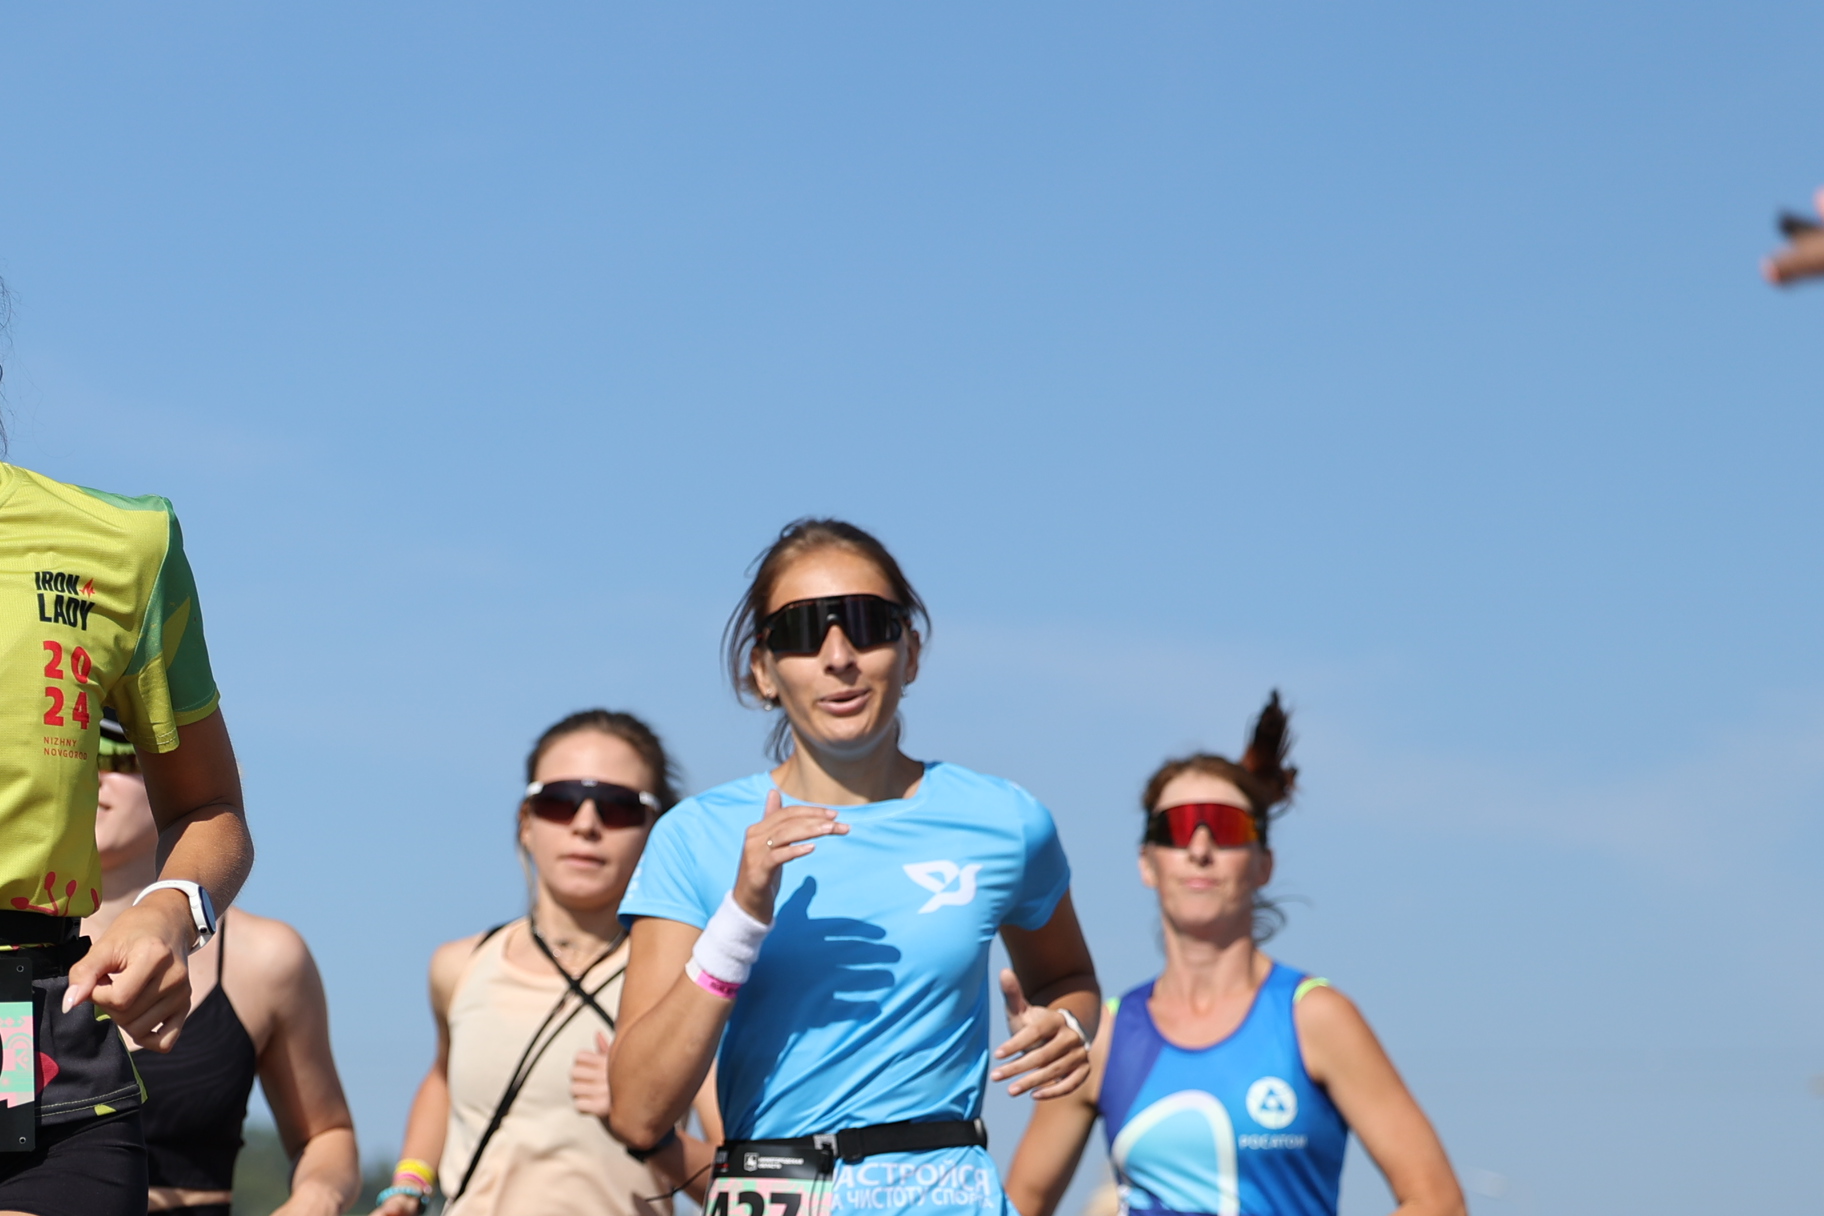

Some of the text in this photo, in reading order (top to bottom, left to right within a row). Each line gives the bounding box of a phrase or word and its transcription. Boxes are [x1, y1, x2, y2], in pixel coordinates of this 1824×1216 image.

[34, 571, 80, 596] IRON
[37, 593, 96, 631] LADY
[43, 640, 92, 684] 20
[43, 686, 90, 730] 24
[43, 736, 77, 747] NIZHNY
[43, 747, 88, 760] NOVGOROD
[832, 1160, 991, 1196] АСТРОЙСЯ
[847, 1186, 925, 1209] ЧИСТОТУ
